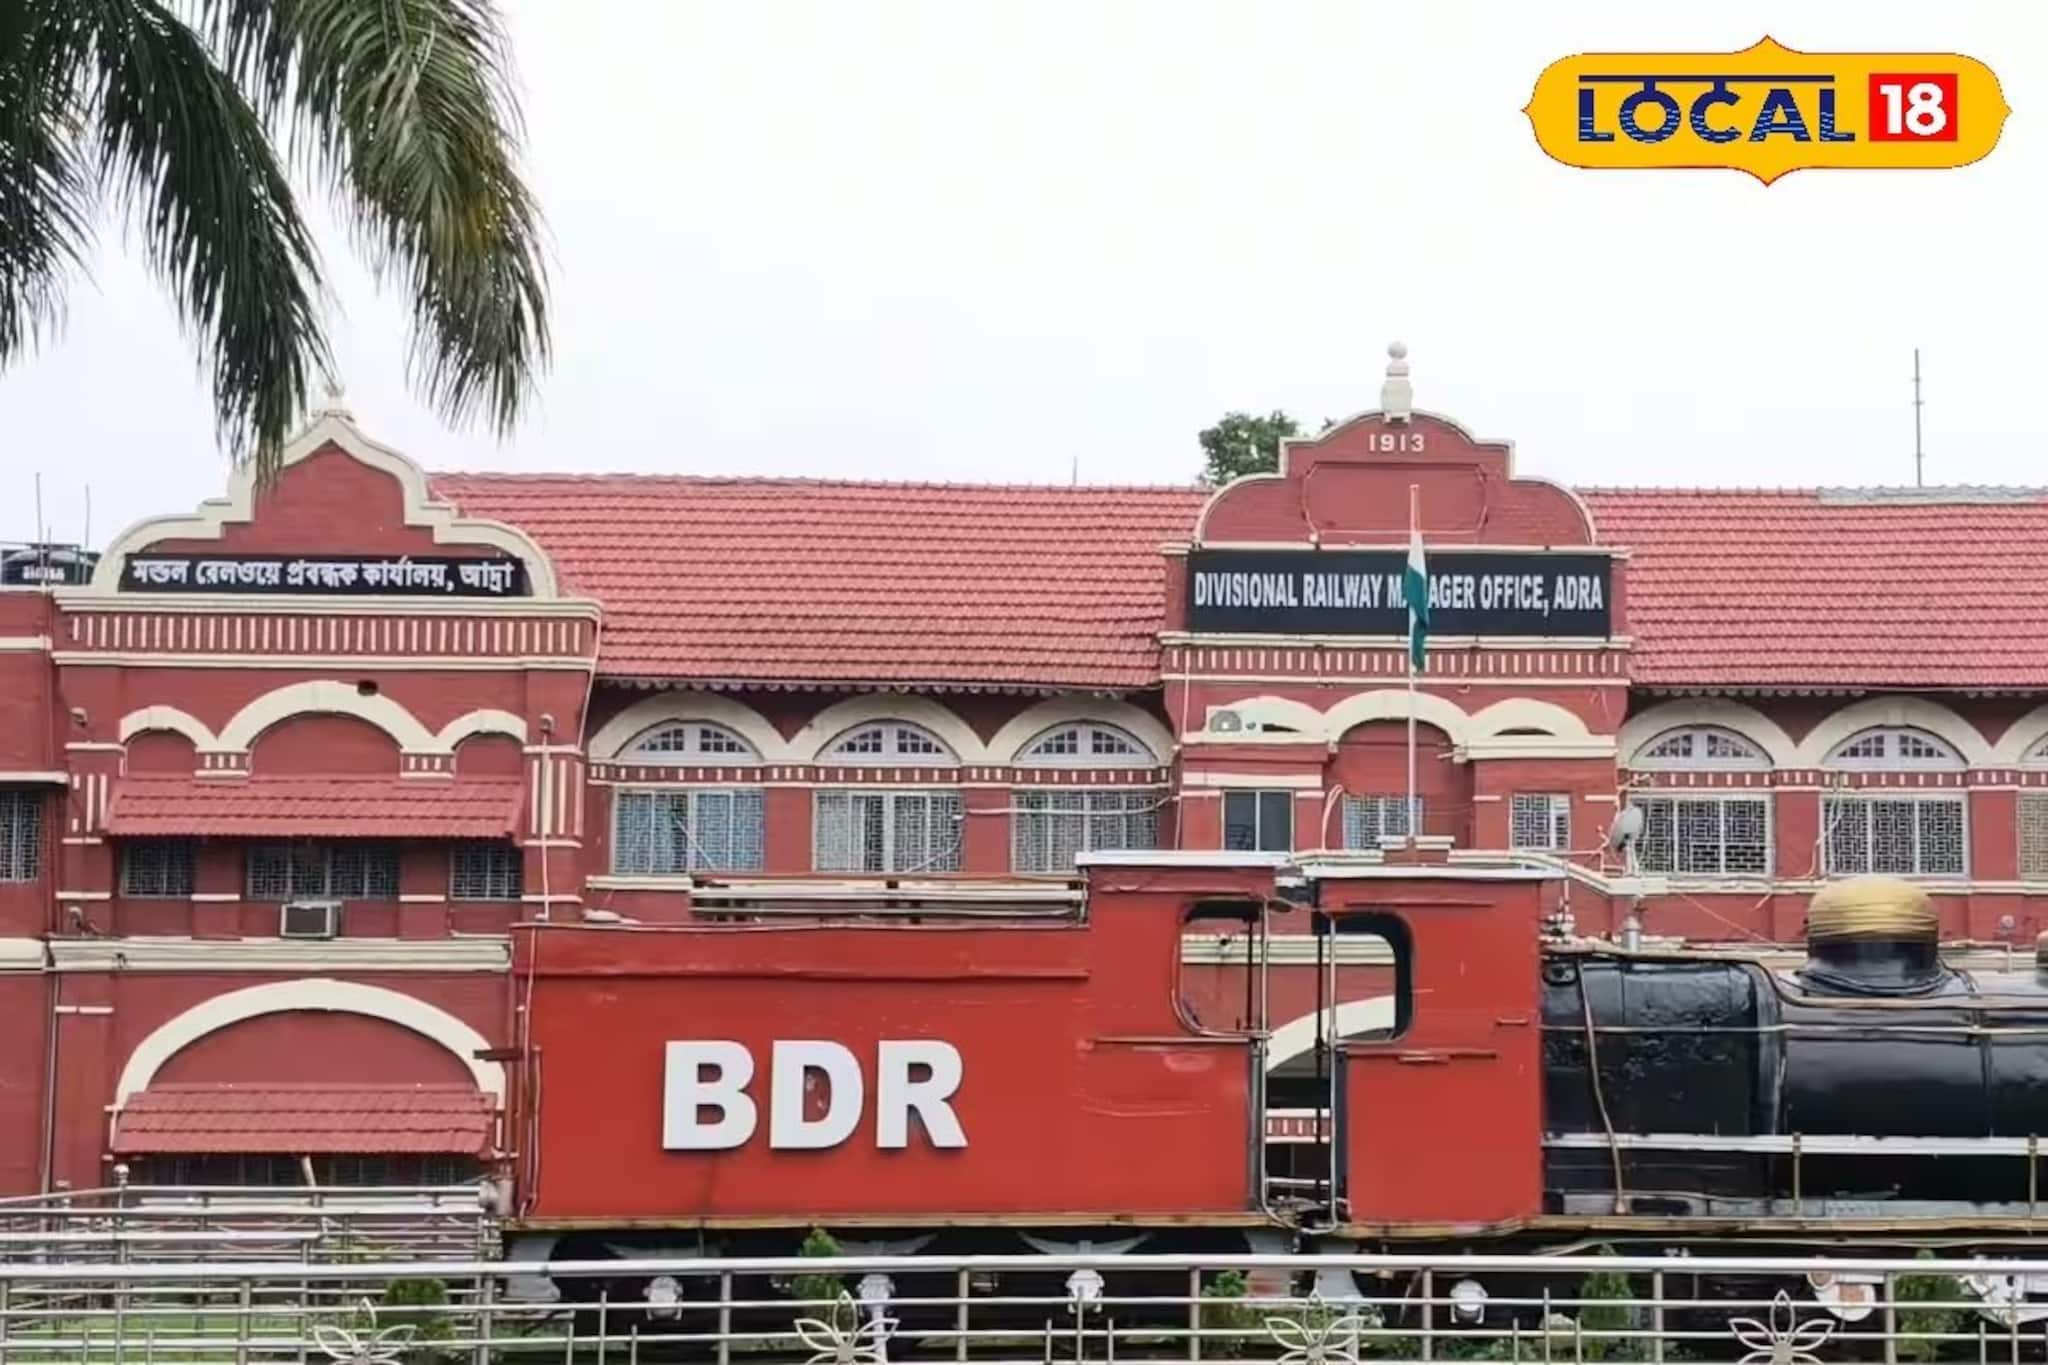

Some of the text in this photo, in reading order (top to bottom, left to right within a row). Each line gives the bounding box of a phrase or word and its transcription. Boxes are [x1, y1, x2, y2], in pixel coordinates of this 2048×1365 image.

[1368, 433, 1425, 453] 1913
[1194, 572, 1603, 617] DIVISIONAL RAILWAY MAGER OFFICE, ADRA
[662, 1039, 968, 1150] BDR
